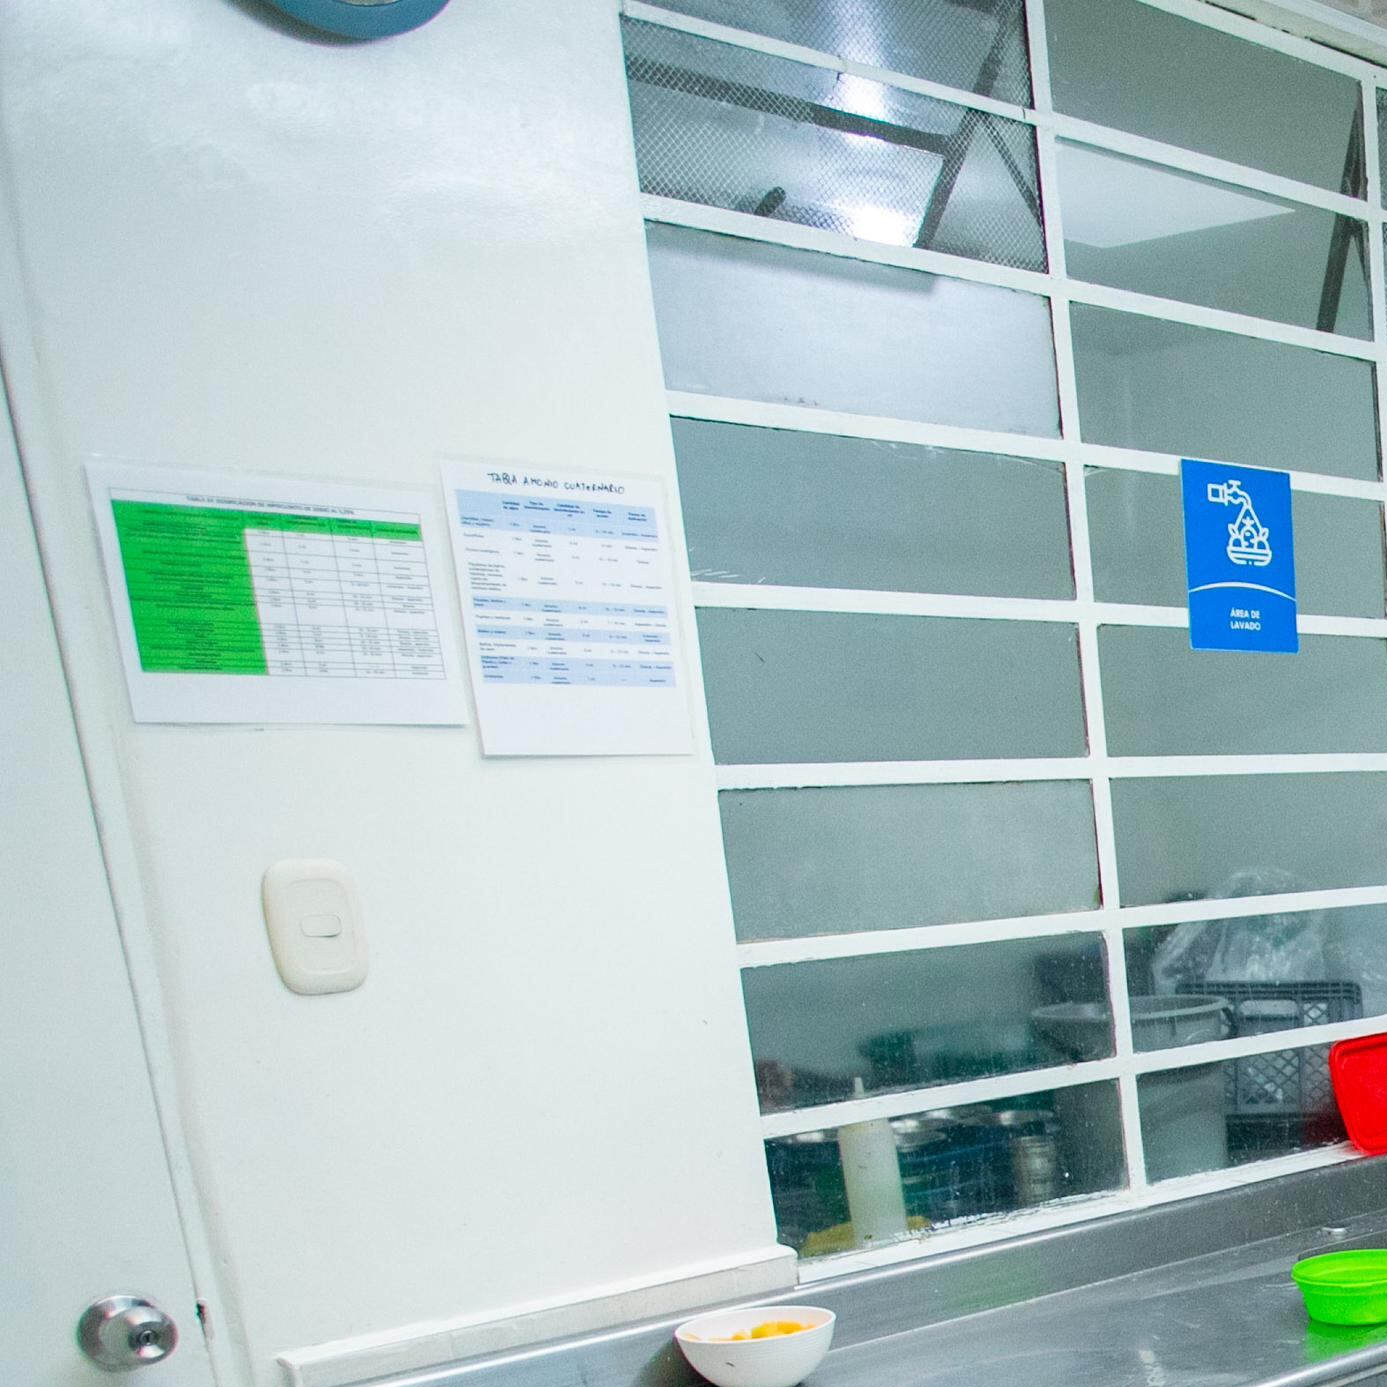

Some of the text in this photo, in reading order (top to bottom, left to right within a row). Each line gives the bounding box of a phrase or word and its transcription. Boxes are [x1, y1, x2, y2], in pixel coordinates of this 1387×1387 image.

[523, 476, 559, 488] AMONIO
[1230, 607, 1260, 619] ÁREA DE
[1230, 621, 1261, 631] LAVADO
